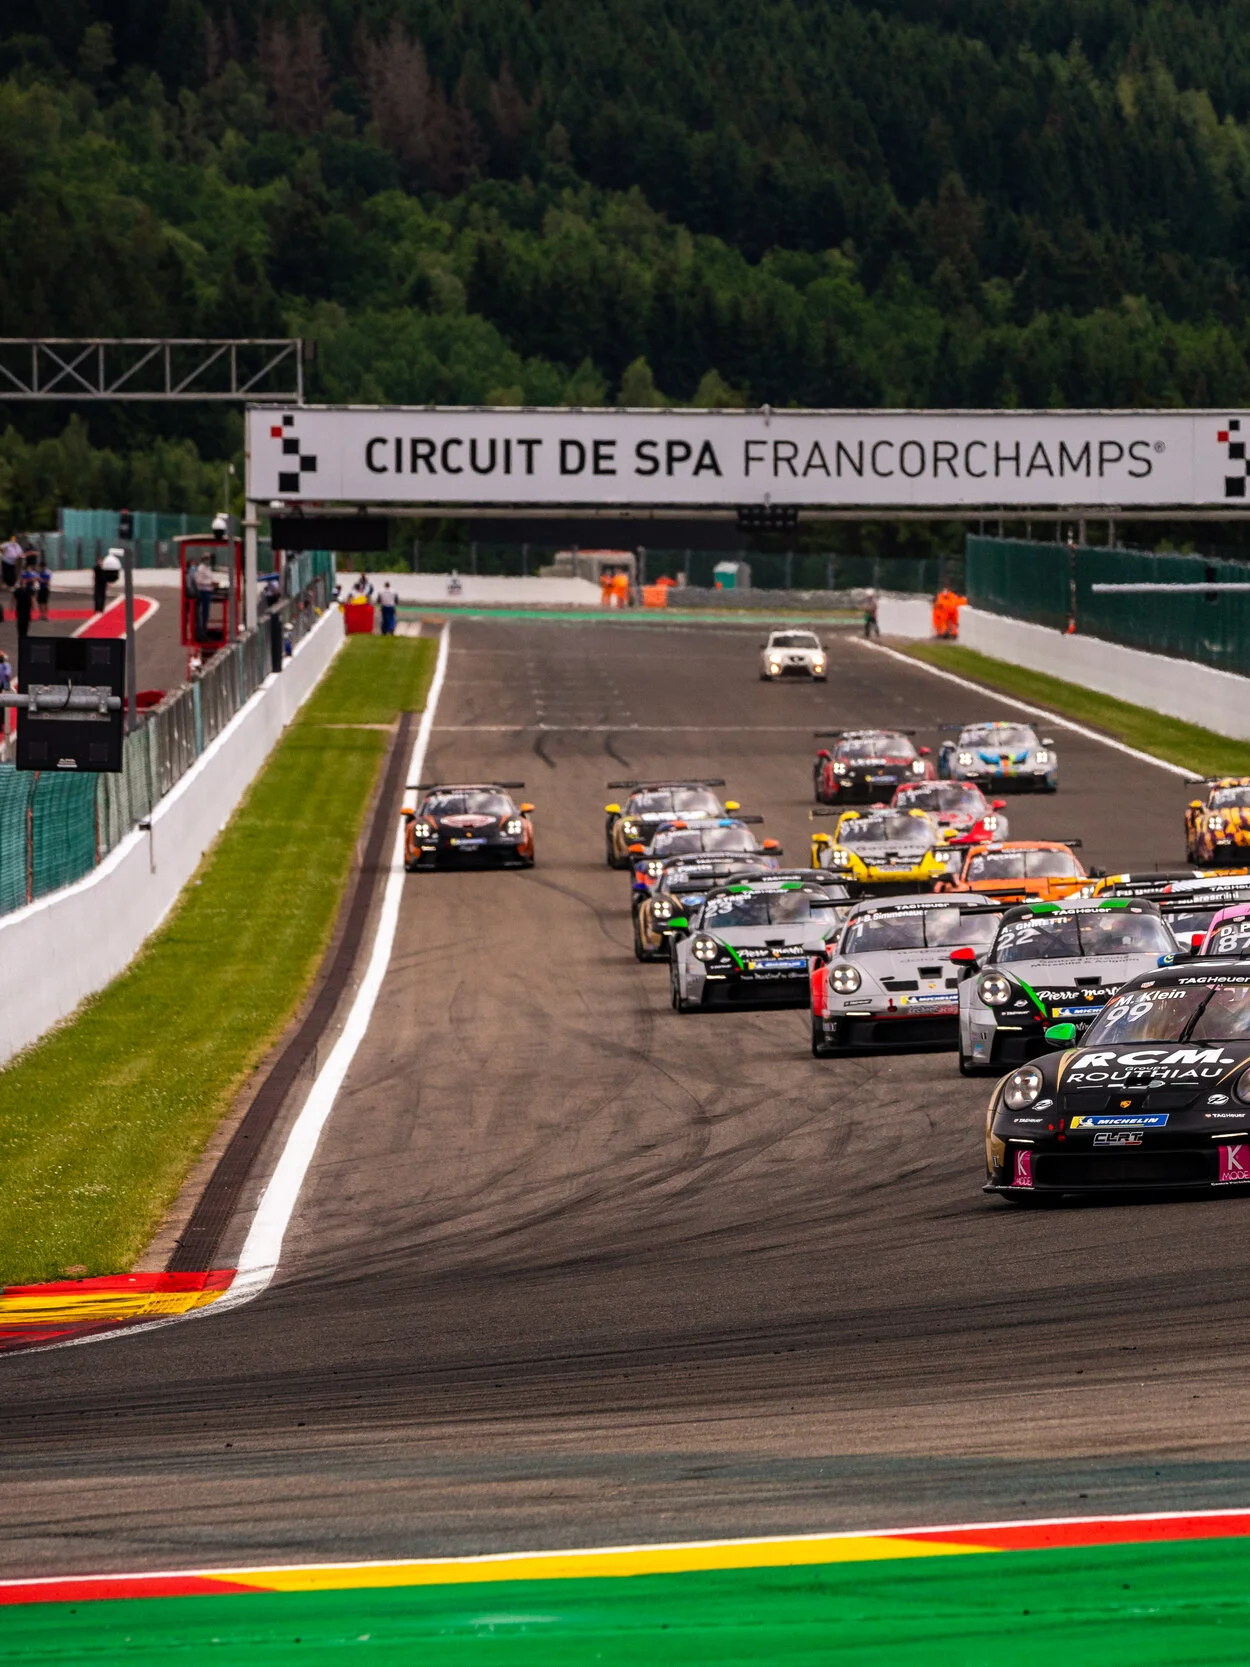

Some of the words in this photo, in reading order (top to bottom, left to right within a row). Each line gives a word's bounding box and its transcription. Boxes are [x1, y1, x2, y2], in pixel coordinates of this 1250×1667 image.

[365, 436, 543, 475] CIRCUIT
[559, 439, 617, 476] DE
[634, 439, 723, 477] SPA
[997, 928, 1041, 951] 22
[1115, 995, 1135, 1007] M.
[1140, 988, 1187, 1001] Klein
[1104, 1001, 1155, 1028] 99
[1070, 1047, 1235, 1070] RCM.
[1066, 1067, 1224, 1084] ROUTHIAU
[1097, 1116, 1159, 1126] MICHELIN
[1226, 1145, 1244, 1171] K
[1222, 1170, 1250, 1181] MODE
